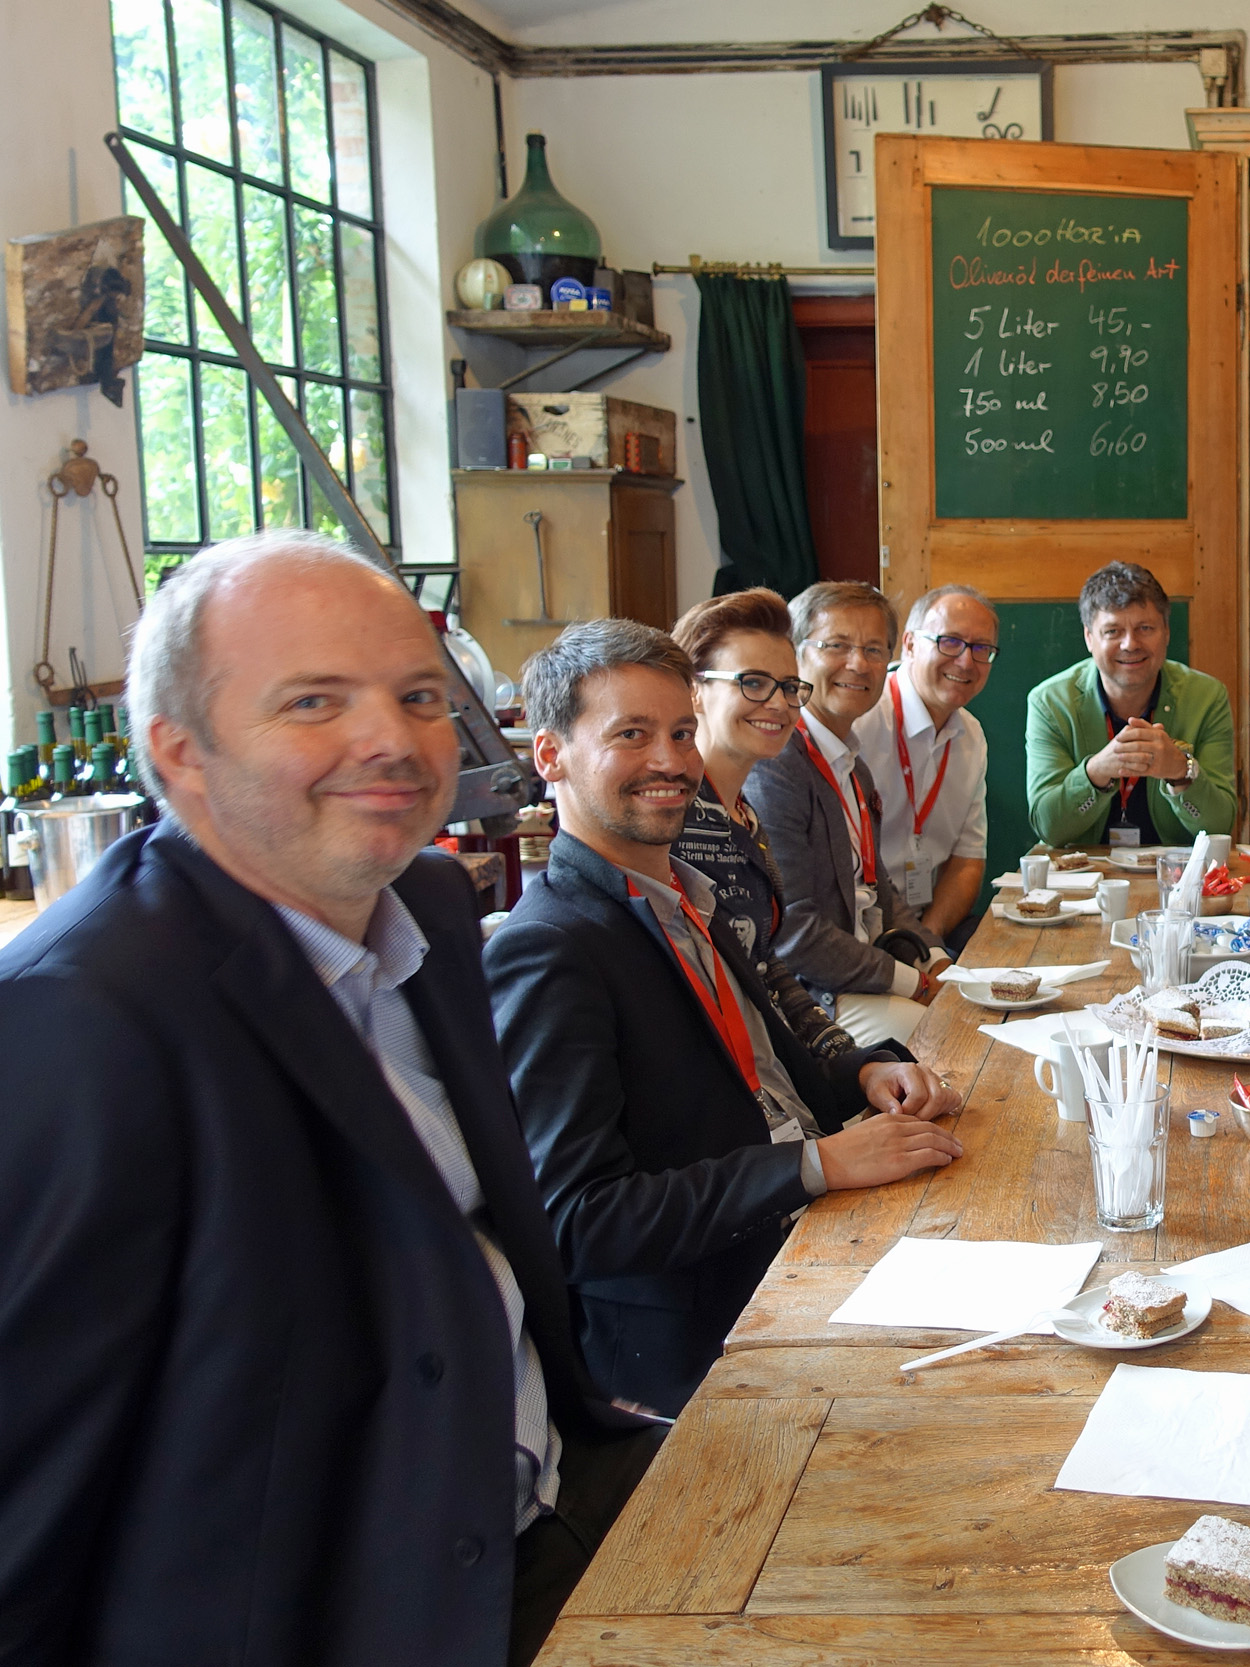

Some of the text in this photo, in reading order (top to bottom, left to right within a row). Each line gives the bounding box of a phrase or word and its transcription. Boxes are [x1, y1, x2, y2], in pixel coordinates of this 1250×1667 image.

[976, 216, 1051, 248] 1000
[950, 255, 1037, 290] Olivenöl
[1143, 257, 1180, 280] Art
[964, 305, 992, 340] 5
[998, 307, 1060, 338] Liter
[963, 347, 984, 377] 1
[1089, 345, 1149, 374] 9,90
[958, 381, 1149, 417] 750 ml 8,50
[964, 421, 1147, 457] 500 ml 6,60
